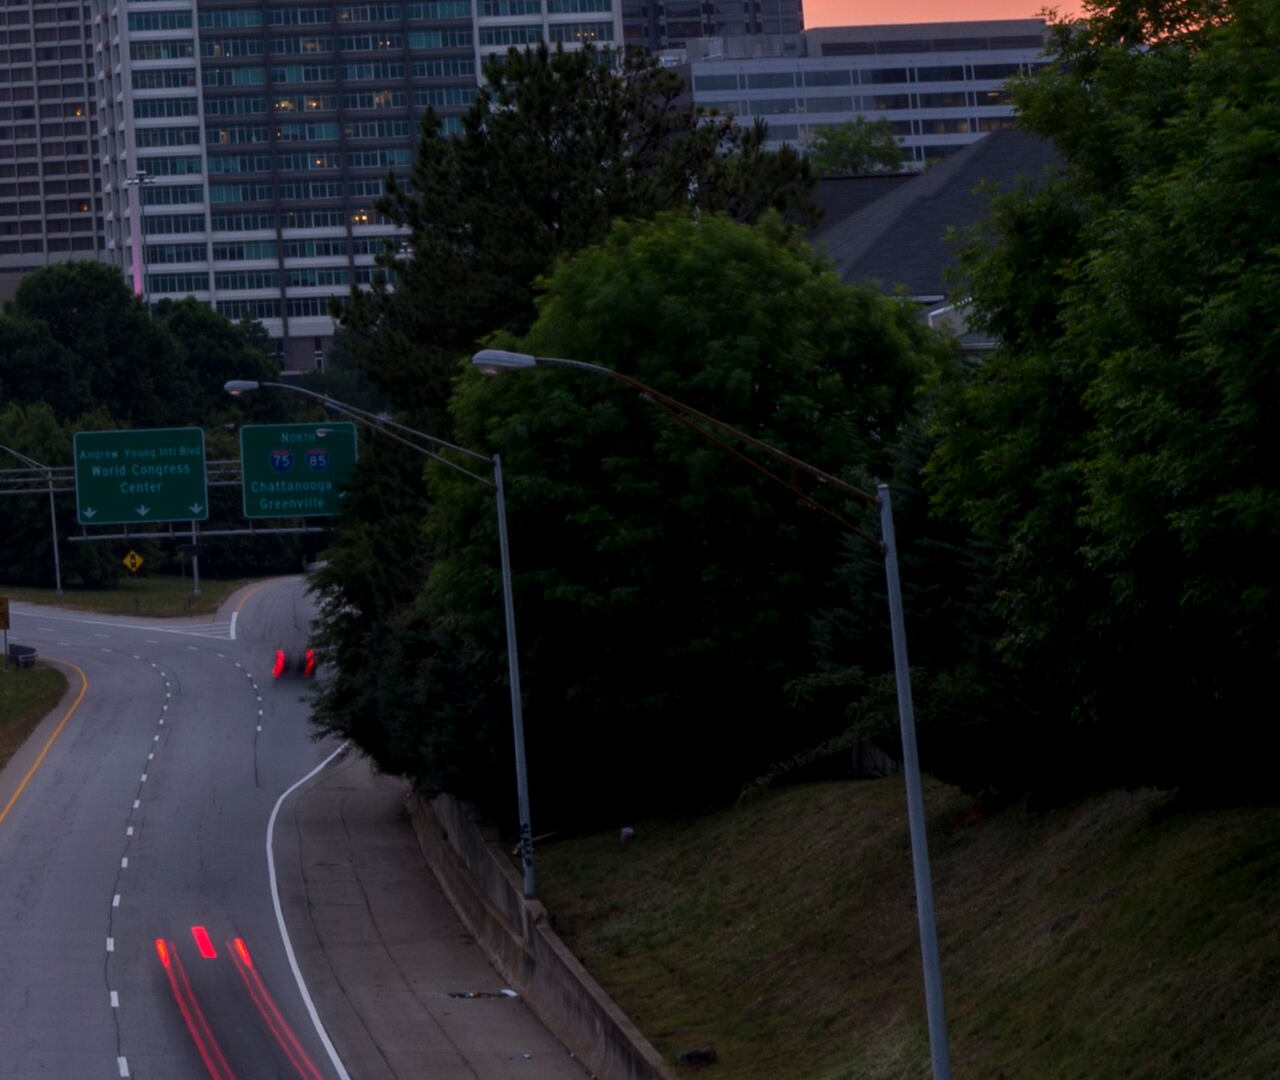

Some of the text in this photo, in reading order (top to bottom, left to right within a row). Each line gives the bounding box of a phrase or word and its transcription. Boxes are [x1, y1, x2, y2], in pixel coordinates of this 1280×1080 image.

[281, 431, 316, 443] NORTH
[79, 449, 119, 460] Andrew
[124, 448, 156, 460] Young
[179, 445, 201, 456] Blvd
[273, 455, 326, 467] 75 85
[91, 463, 190, 478] World Congress
[120, 481, 162, 494] Center
[251, 480, 333, 494] Chattanooga
[260, 496, 325, 510] Greenville
